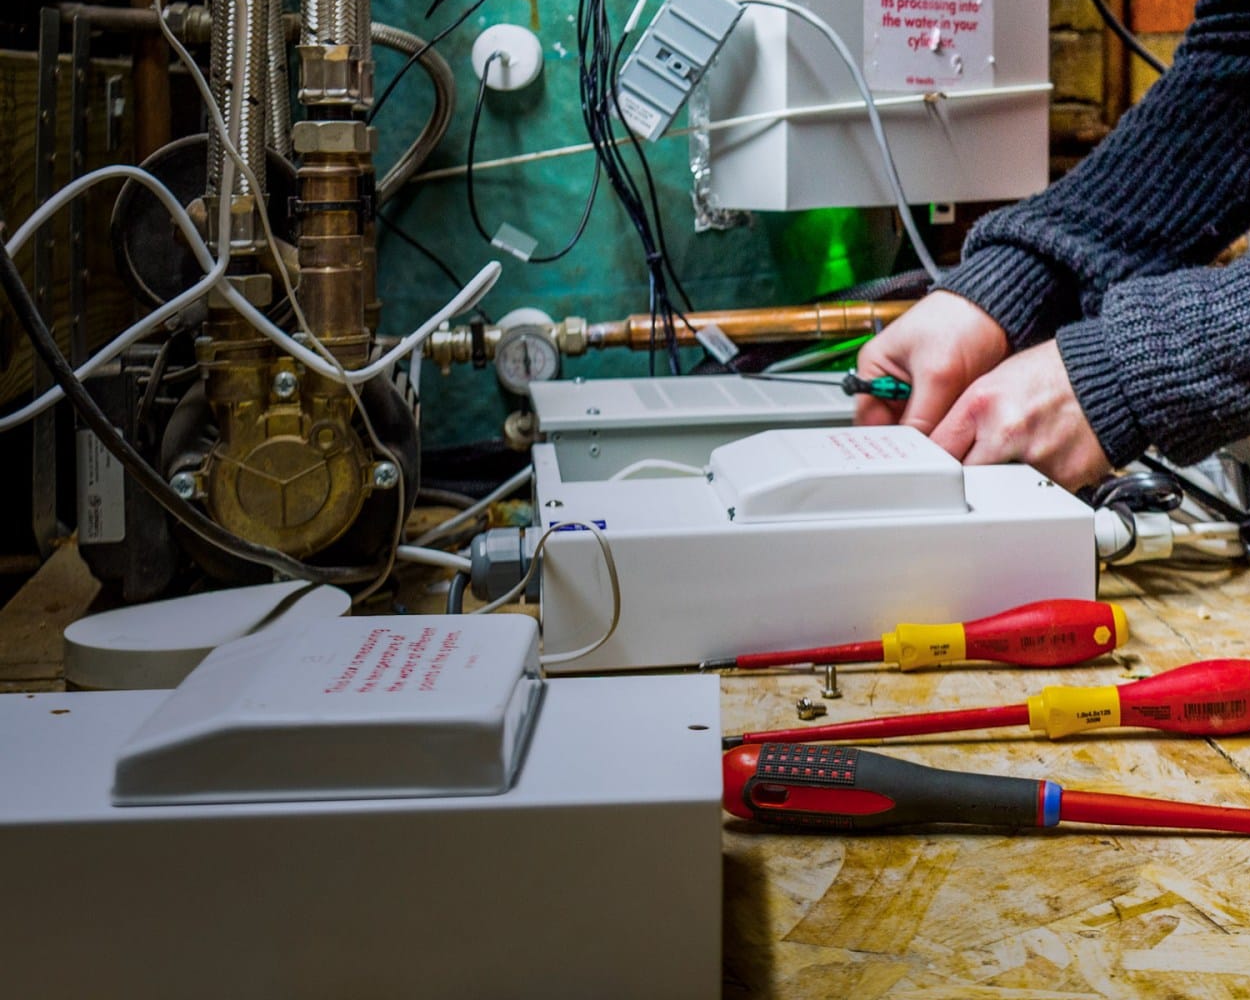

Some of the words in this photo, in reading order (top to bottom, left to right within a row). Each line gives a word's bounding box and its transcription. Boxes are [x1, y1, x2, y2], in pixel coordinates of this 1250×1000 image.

[882, 12, 901, 27] the
[905, 16, 938, 28] water
[940, 15, 950, 29] in
[953, 20, 978, 34] your
